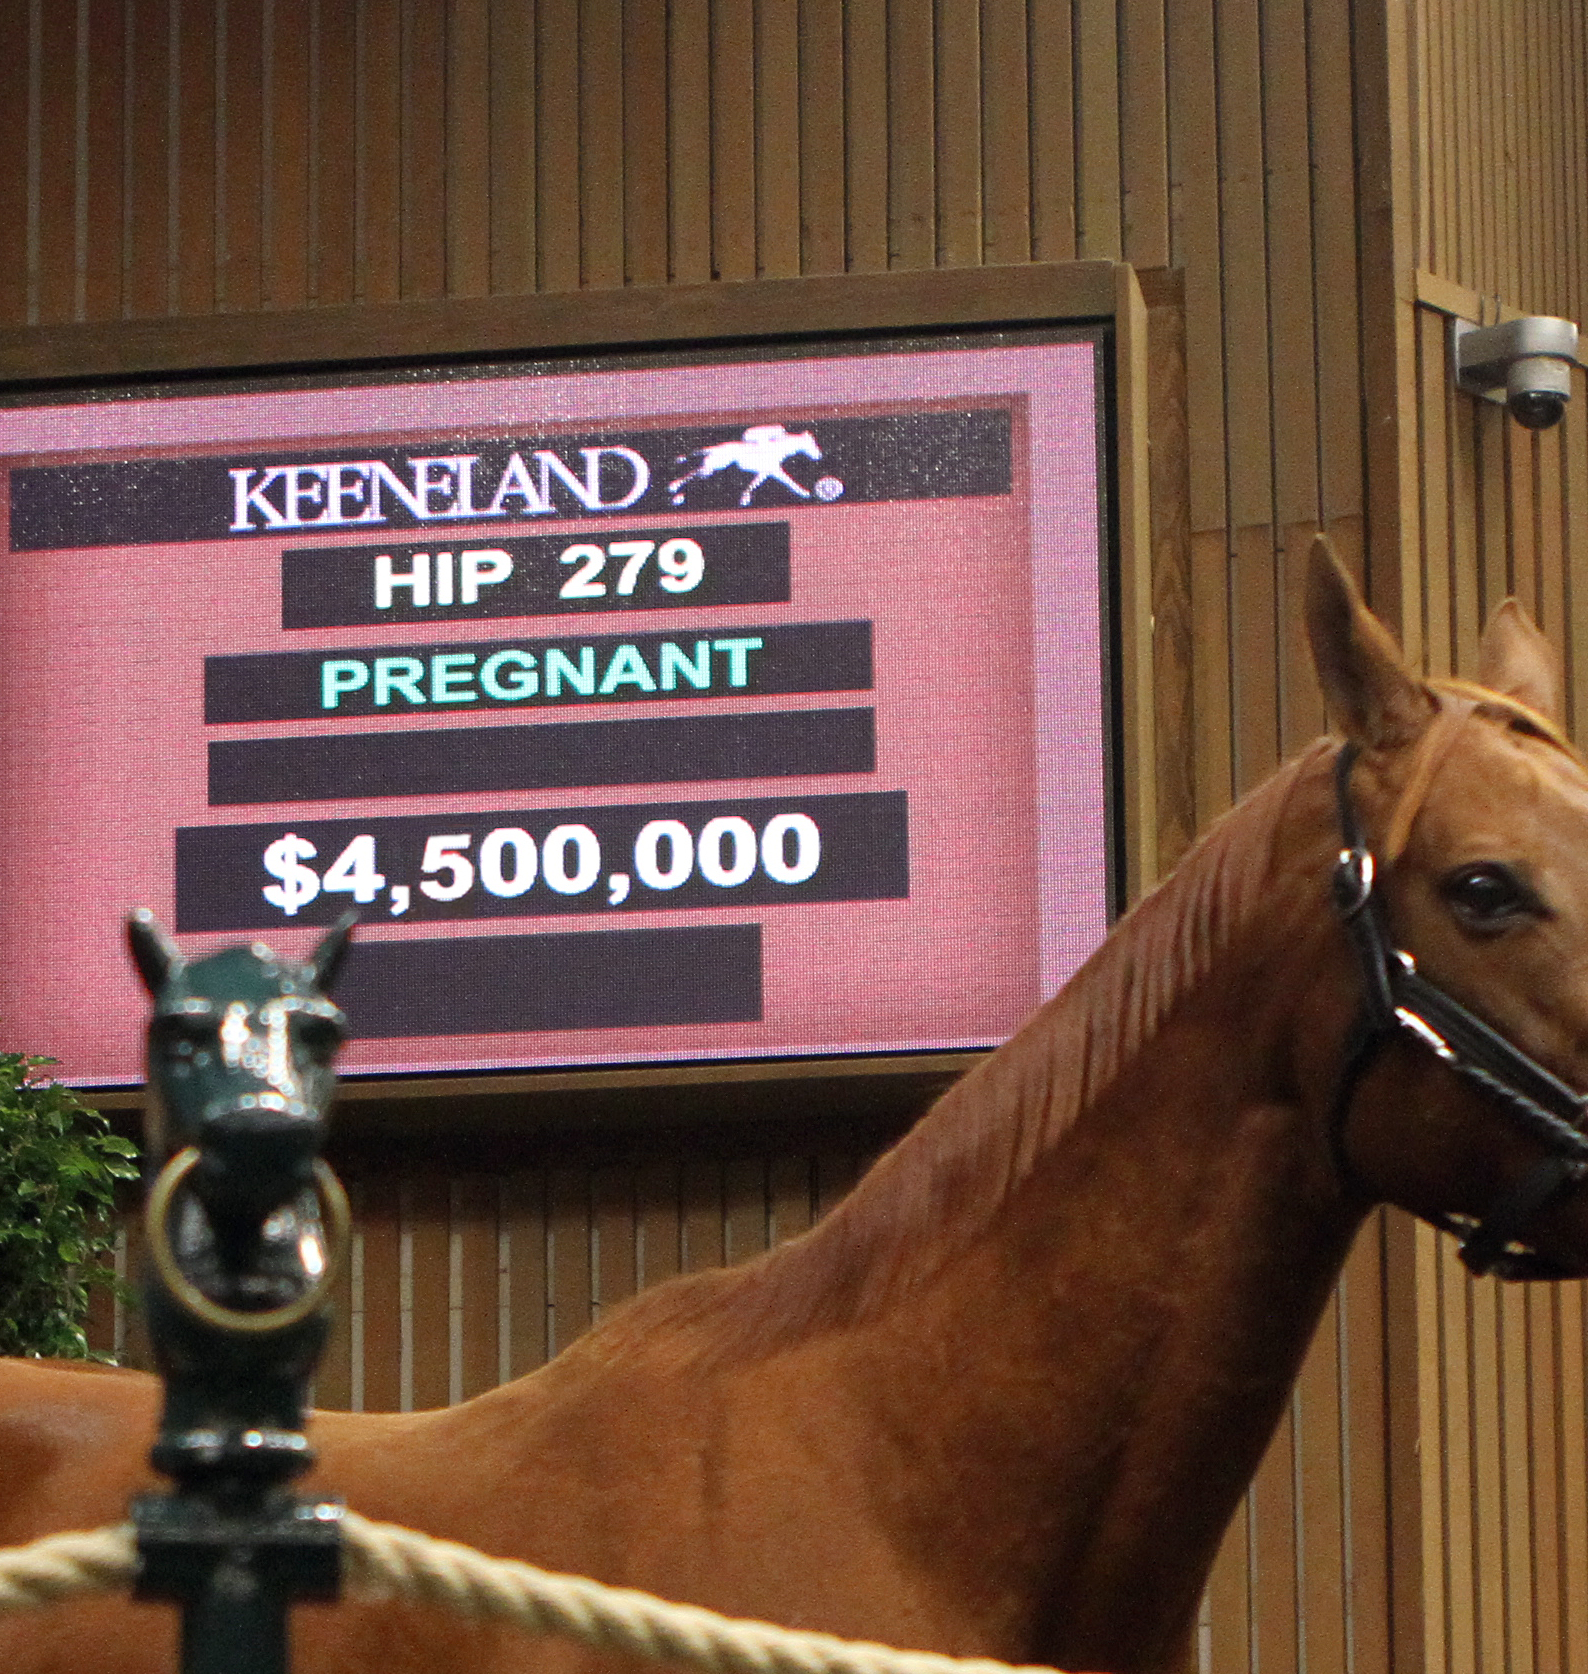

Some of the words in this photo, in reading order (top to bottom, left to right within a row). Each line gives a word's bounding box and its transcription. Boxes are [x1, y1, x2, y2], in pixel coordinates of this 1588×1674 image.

[229, 446, 651, 531] KEENELAND
[374, 549, 514, 610] HIP
[559, 538, 705, 600] 279
[321, 637, 763, 709] PREGNANT
[263, 813, 821, 916] $4,500,000
